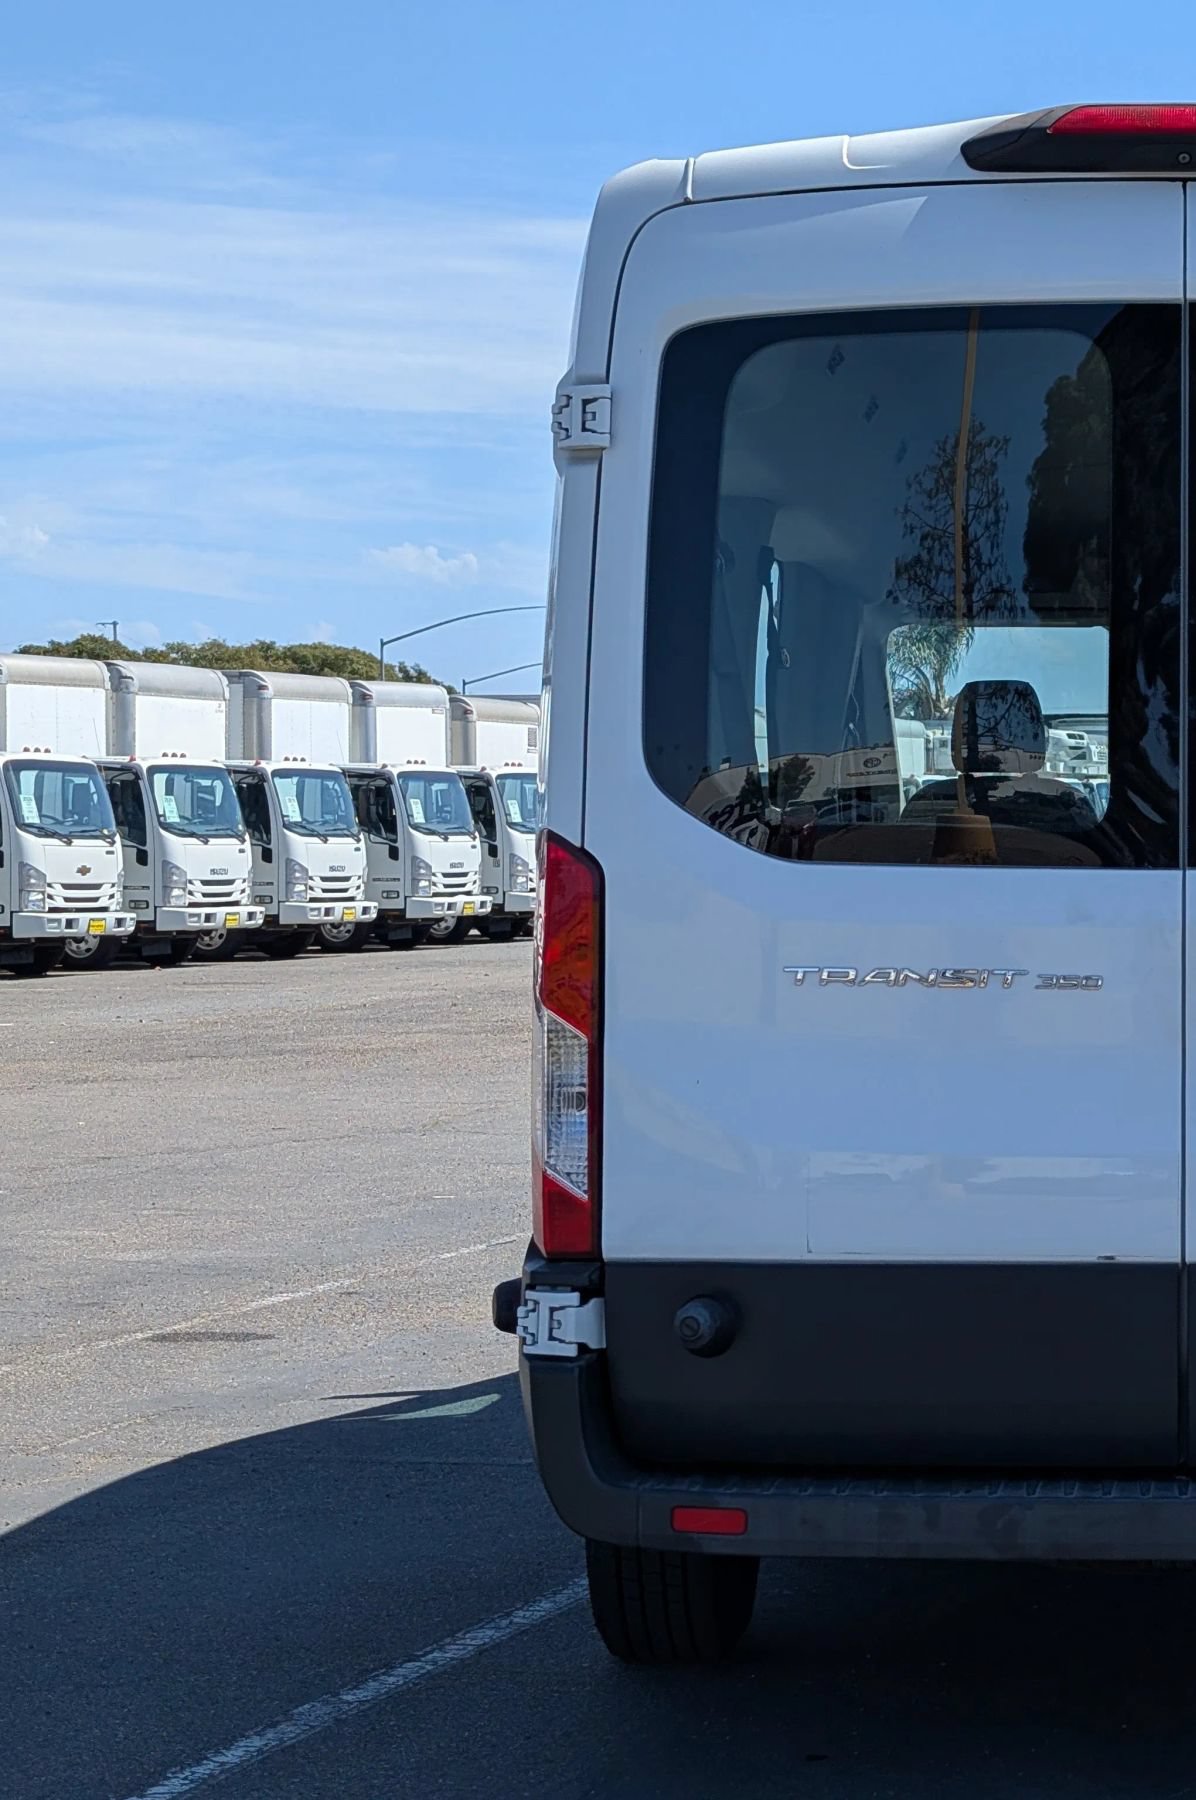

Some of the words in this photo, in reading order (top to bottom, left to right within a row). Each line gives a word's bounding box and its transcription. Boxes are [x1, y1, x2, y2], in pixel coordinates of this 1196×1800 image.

[210, 868, 228, 876] ISUZU
[783, 967, 1029, 989] TRANSIT
[1035, 974, 1104, 991] 350
